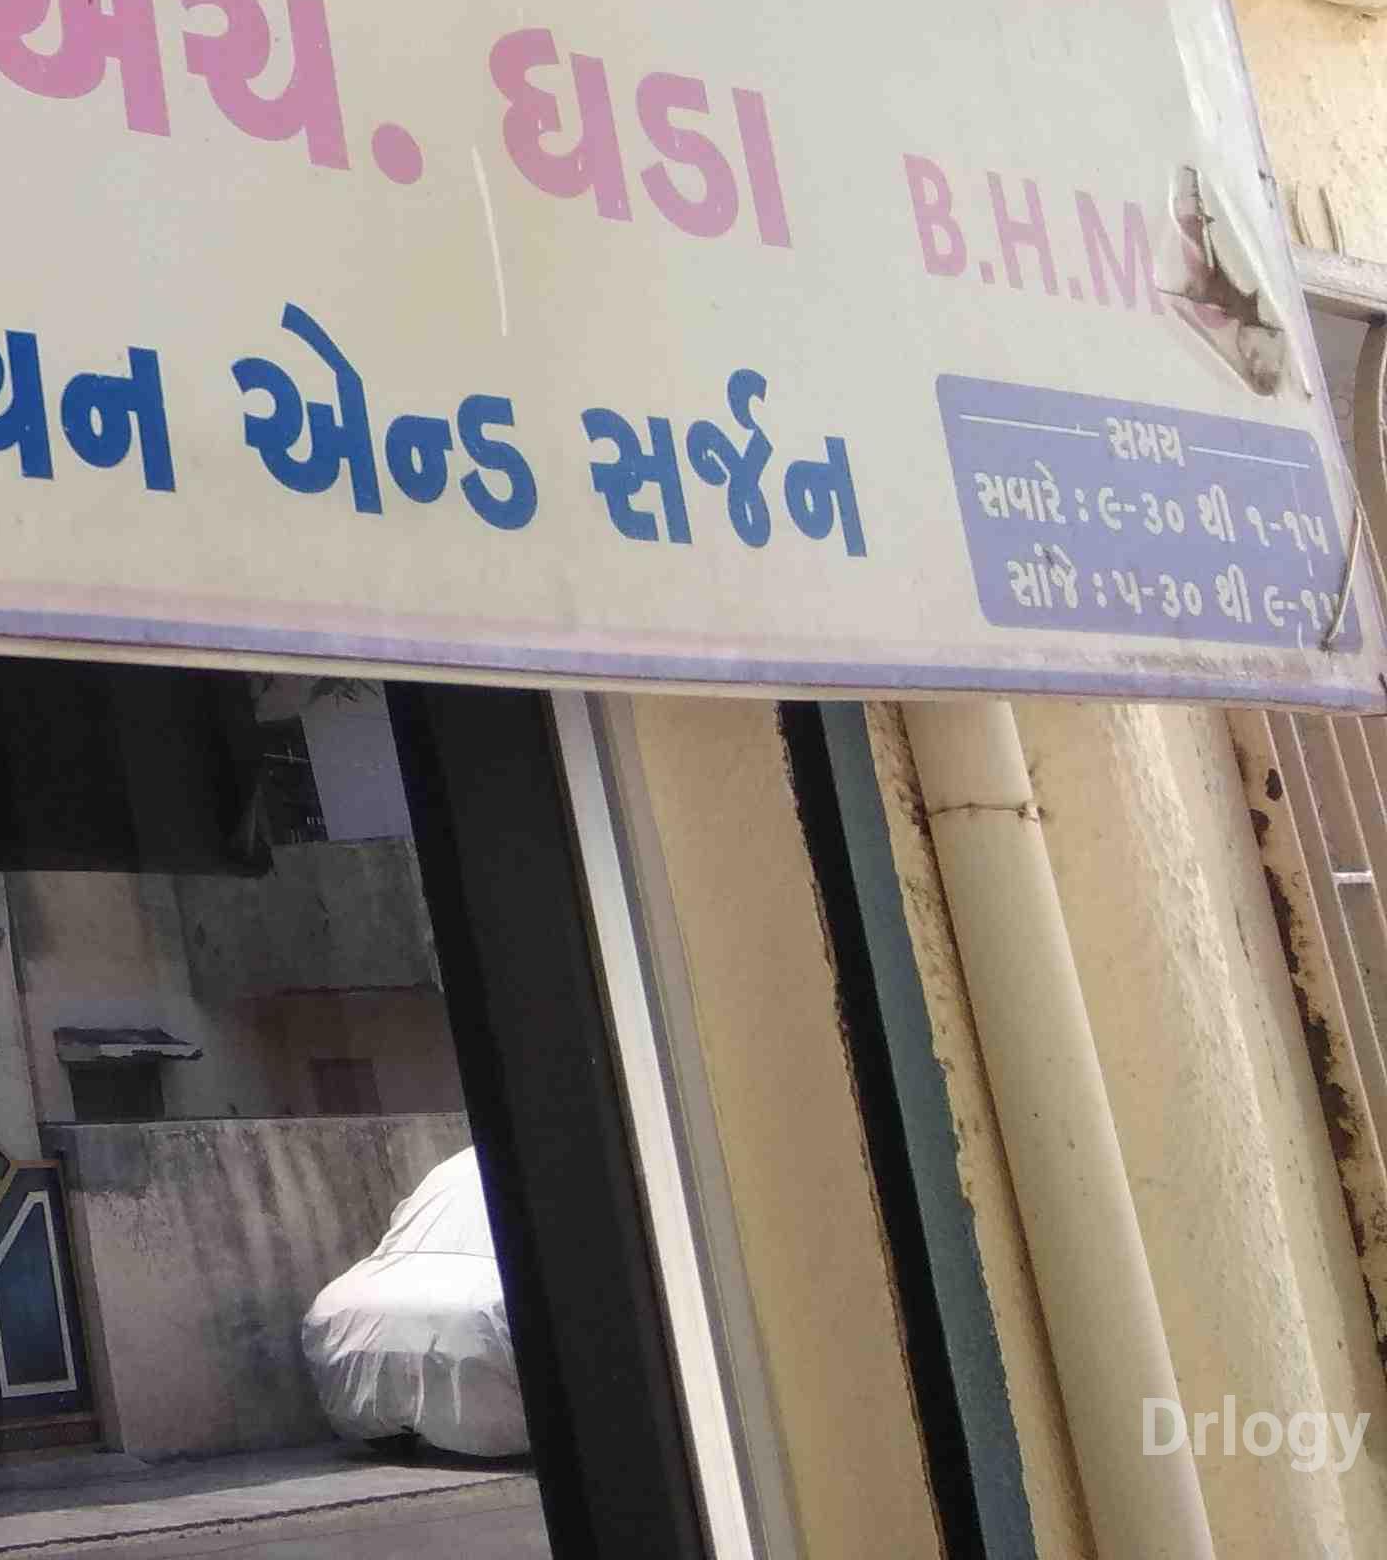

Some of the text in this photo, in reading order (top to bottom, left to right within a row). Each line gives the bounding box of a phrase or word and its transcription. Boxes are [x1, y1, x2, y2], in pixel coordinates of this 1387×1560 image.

[231, 303, 537, 530] એન્ડ
[582, 369, 868, 558] સર્જન
[1105, 416, 1186, 466] સમય
[975, 460, 1066, 525] સવારે
[1198, 484, 1236, 542] થી
[1007, 542, 1079, 608] સાંજે
[1216, 565, 1251, 623] થી
